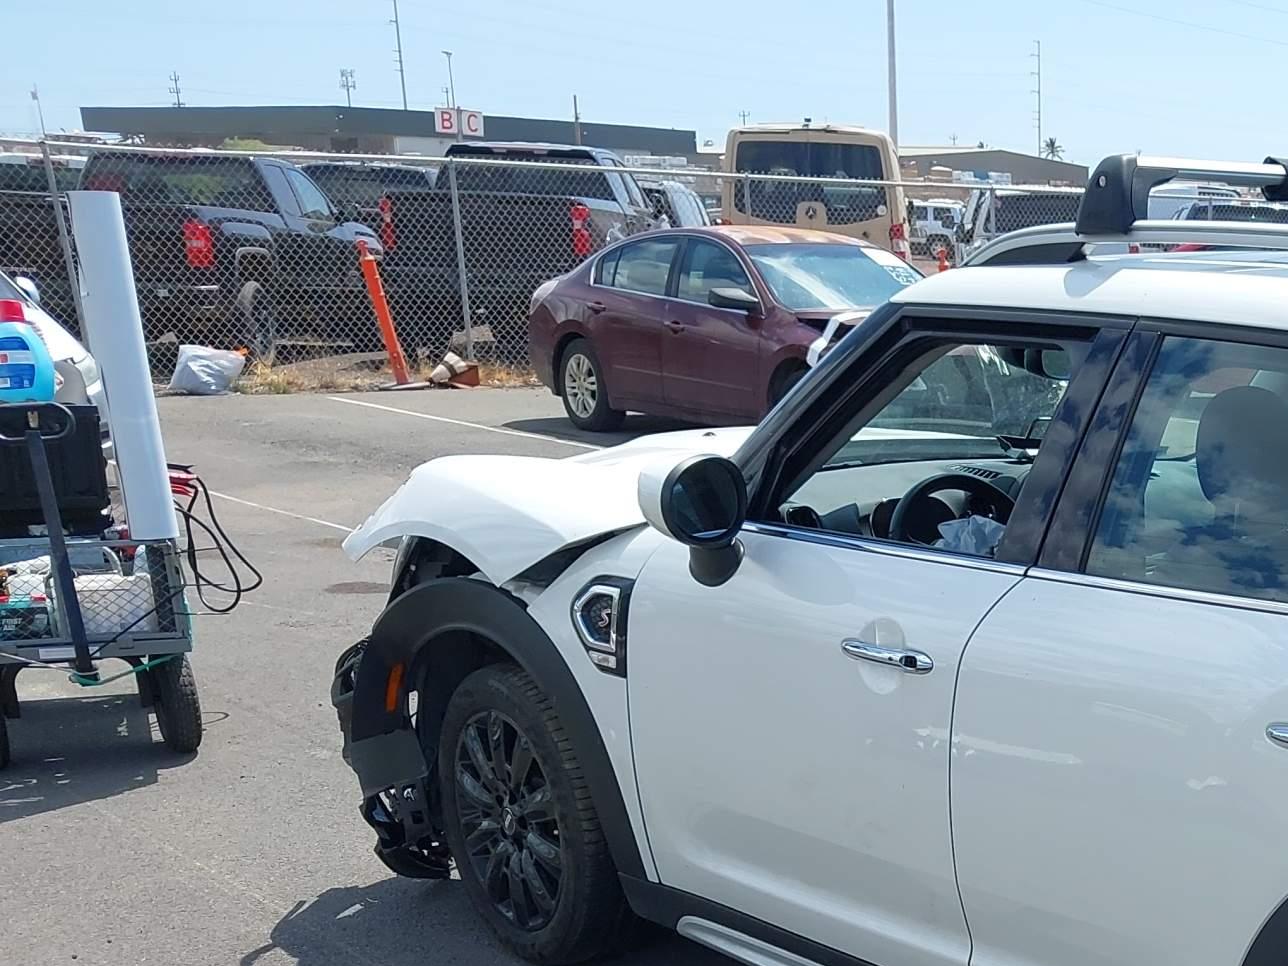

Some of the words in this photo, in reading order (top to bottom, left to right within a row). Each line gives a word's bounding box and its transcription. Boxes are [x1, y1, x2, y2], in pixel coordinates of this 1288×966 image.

[441, 111, 453, 130] B
[467, 113, 478, 132] C
[598, 608, 611, 627] S
